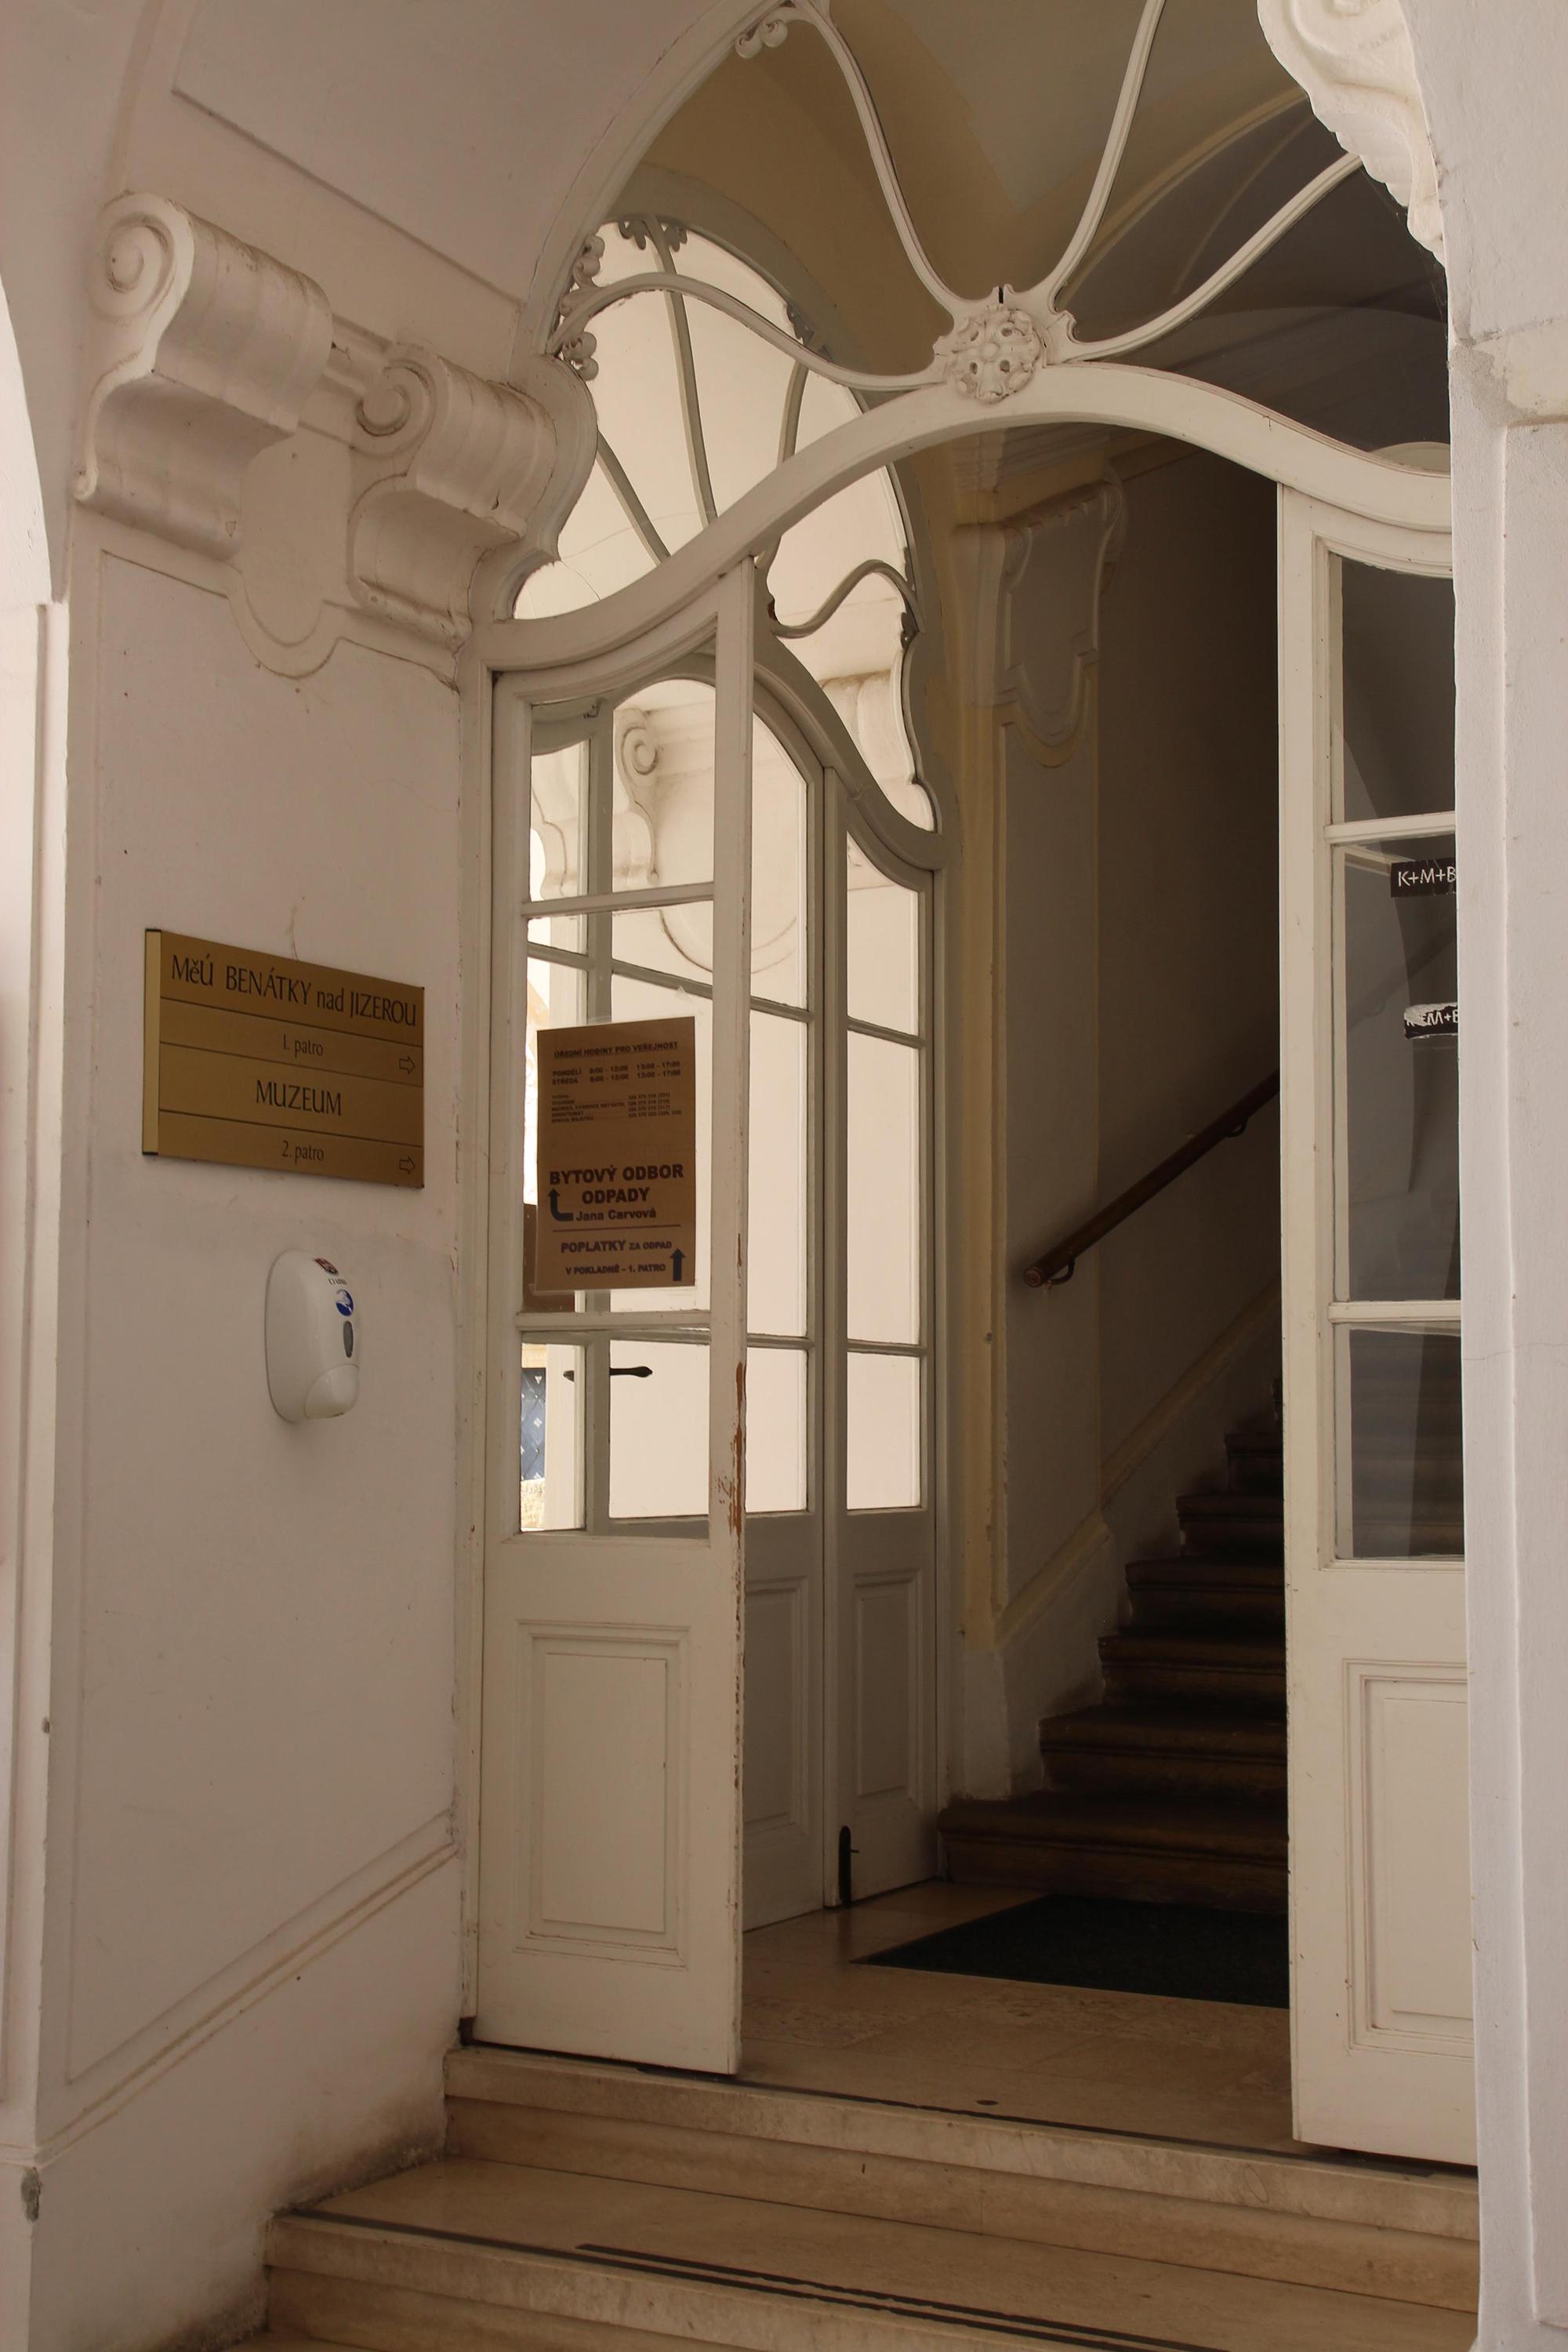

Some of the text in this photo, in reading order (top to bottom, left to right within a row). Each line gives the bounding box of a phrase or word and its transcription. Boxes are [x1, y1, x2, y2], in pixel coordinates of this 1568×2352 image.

[171, 953, 416, 1027] MěÚ BENÁTKY nad JIZEROU
[293, 1036, 324, 1058] patro
[583, 1045, 613, 1058] HODINY
[615, 1044, 631, 1054] PRO
[632, 1041, 678, 1052] VEŘEJNOST
[255, 1079, 343, 1116] MUZEUM
[281, 1140, 325, 1165] 2. patro
[550, 1163, 684, 1185] BYTOVÝ ODBOR
[581, 1186, 651, 1204] ODPADY
[575, 1211, 604, 1222] Jana
[561, 1240, 673, 1254] POPLATKY ZA ODPAD
[565, 1267, 572, 1276] V
[573, 1263, 620, 1275] POKLADNĚ
[637, 1263, 666, 1273] PATRO
